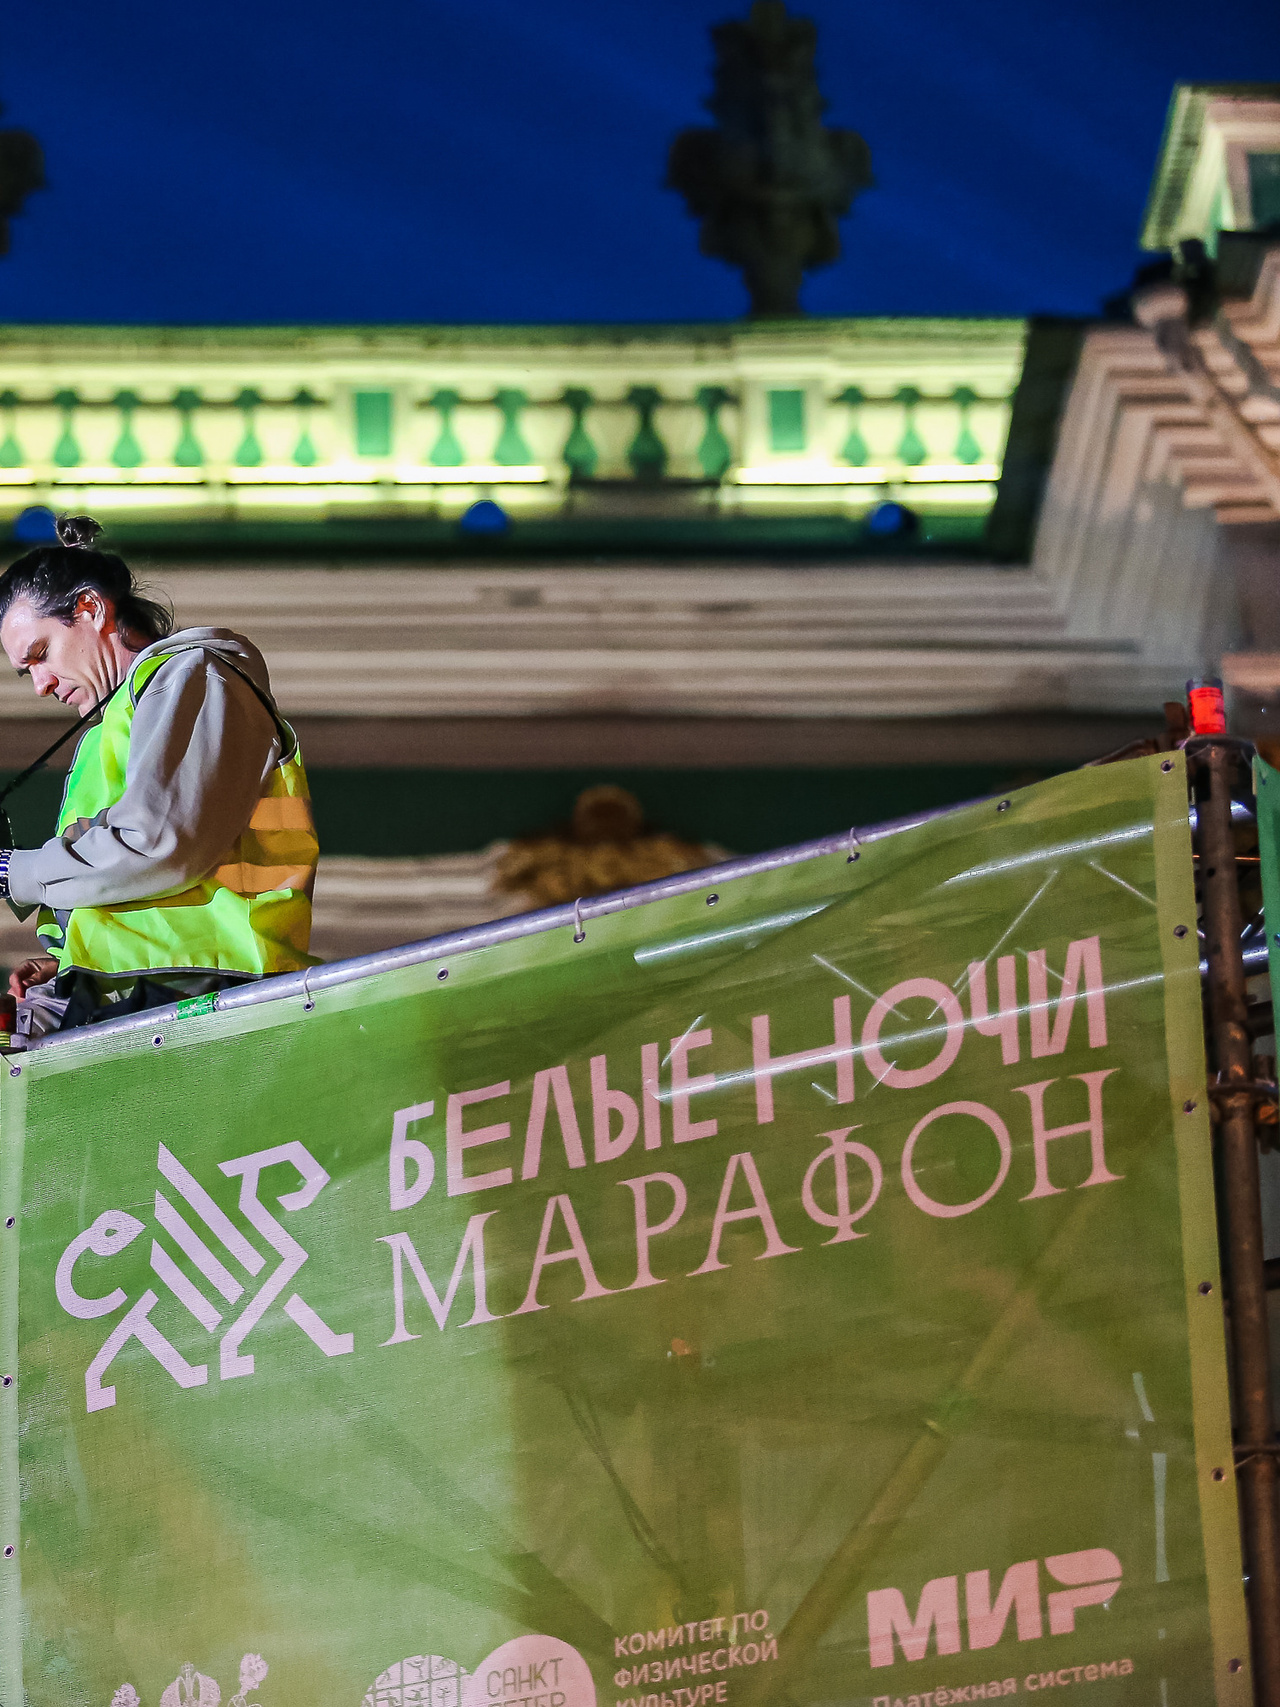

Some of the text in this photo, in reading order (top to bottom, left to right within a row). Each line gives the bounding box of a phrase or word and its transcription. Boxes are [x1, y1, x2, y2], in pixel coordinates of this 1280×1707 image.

[389, 936, 1109, 1211] БЕЛЫЕ НОЧИ
[375, 1068, 1126, 1347] МАРАФОН
[614, 1609, 770, 1658] КОМИТЕТ ПО
[867, 1547, 1123, 1668] МИР
[487, 1658, 563, 1698] САНКТ
[613, 1633, 779, 1688] ФИЗИЧЕСКОЙ
[1024, 1658, 1134, 1692] система
